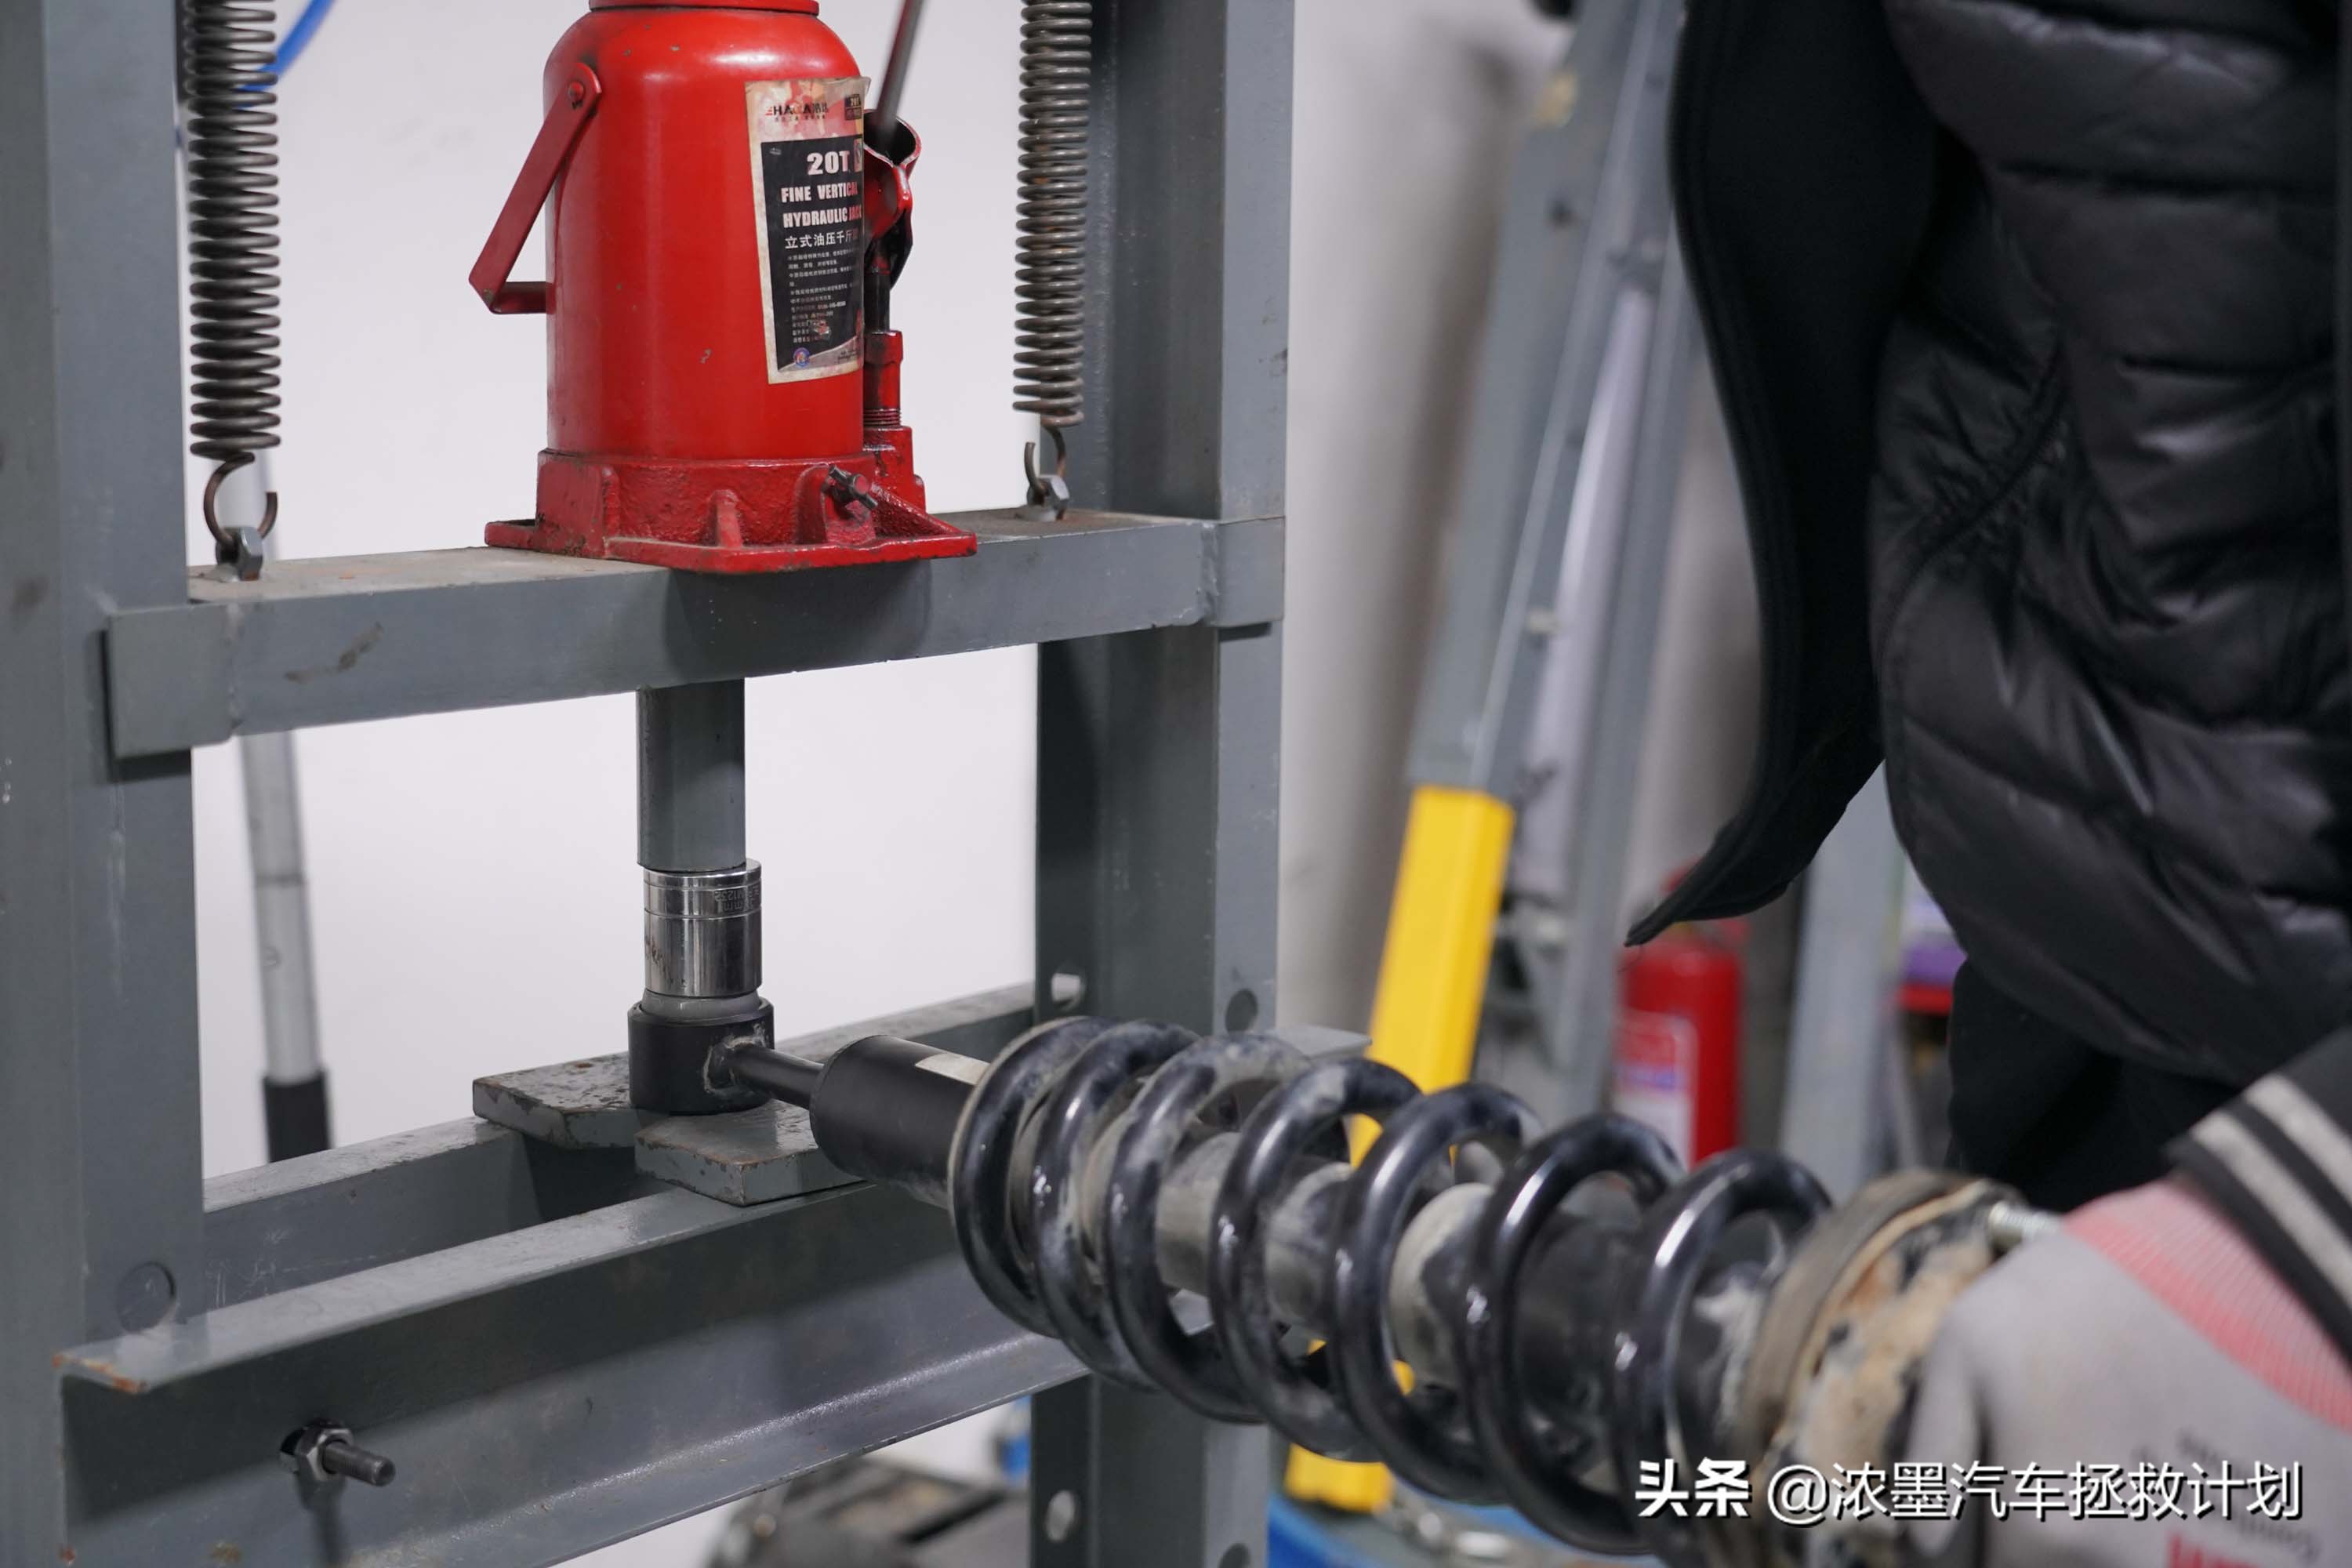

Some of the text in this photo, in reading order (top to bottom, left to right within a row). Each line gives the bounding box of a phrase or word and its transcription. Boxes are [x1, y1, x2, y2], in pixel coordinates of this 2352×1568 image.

[807, 151, 851, 176] 20T
[781, 182, 858, 203] FINE VERTICAL
[782, 209, 848, 228] HYDRAULIC
